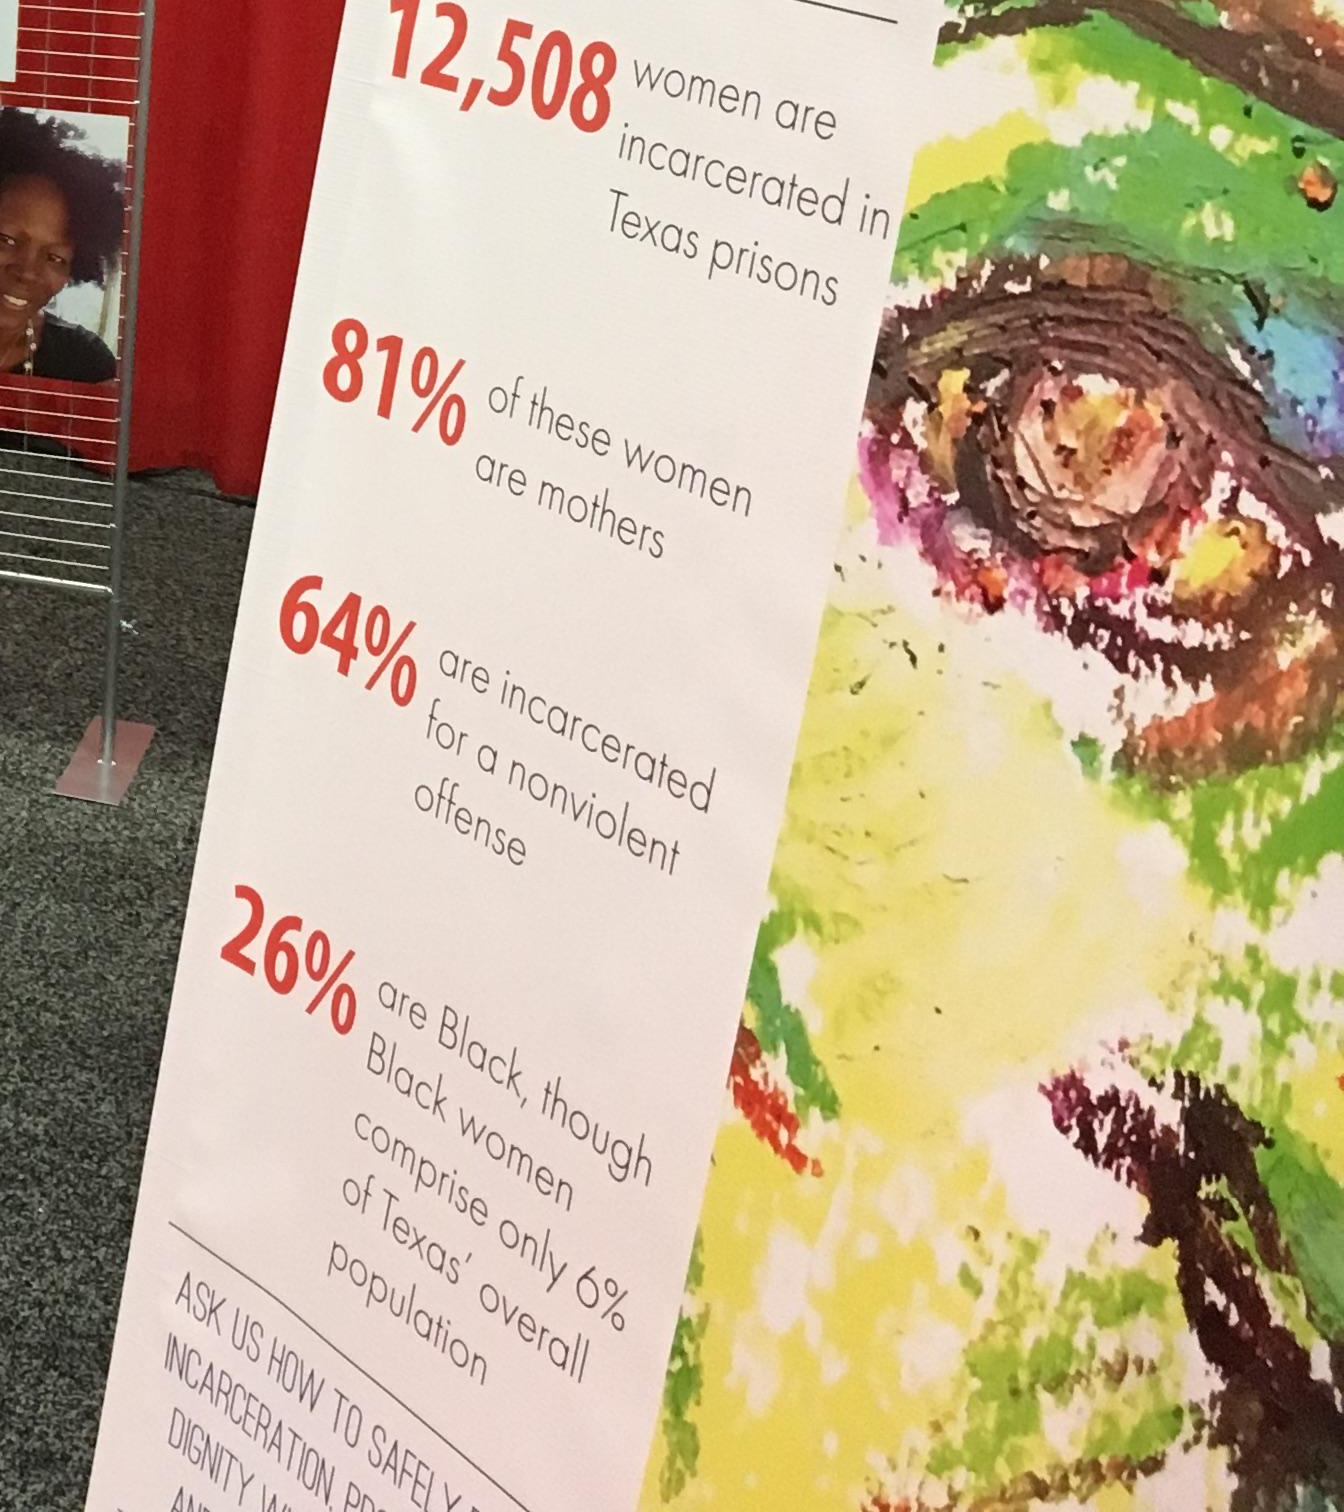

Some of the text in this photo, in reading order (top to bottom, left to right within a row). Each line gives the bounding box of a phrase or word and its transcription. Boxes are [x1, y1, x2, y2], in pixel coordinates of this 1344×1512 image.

[619, 122, 889, 240] incarcerated in
[634, 60, 760, 120] women
[775, 100, 836, 140] are
[610, 188, 838, 306] Texas prisons
[323, 318, 751, 517] 81% of these women
[476, 454, 664, 559] are mothers
[280, 576, 716, 814] 64% are incarcerated
[415, 779, 526, 866] offense
[426, 698, 679, 876] for a nonviolent
[220, 885, 652, 1187] 26% are Black, though
[367, 1031, 572, 1212] Black women
[343, 1175, 374, 1214] of
[480, 1284, 589, 1384] overall
[354, 1113, 628, 1332] comprise only 6%
[174, 1272, 227, 1336] ASK
[232, 1307, 263, 1362] US
[267, 1337, 325, 1412] HOW
[333, 1387, 362, 1448] TO
[368, 1425, 462, 1512] SAFELY
[327, 1241, 487, 1386] population
[168, 1407, 255, 1507] DIGNITY
